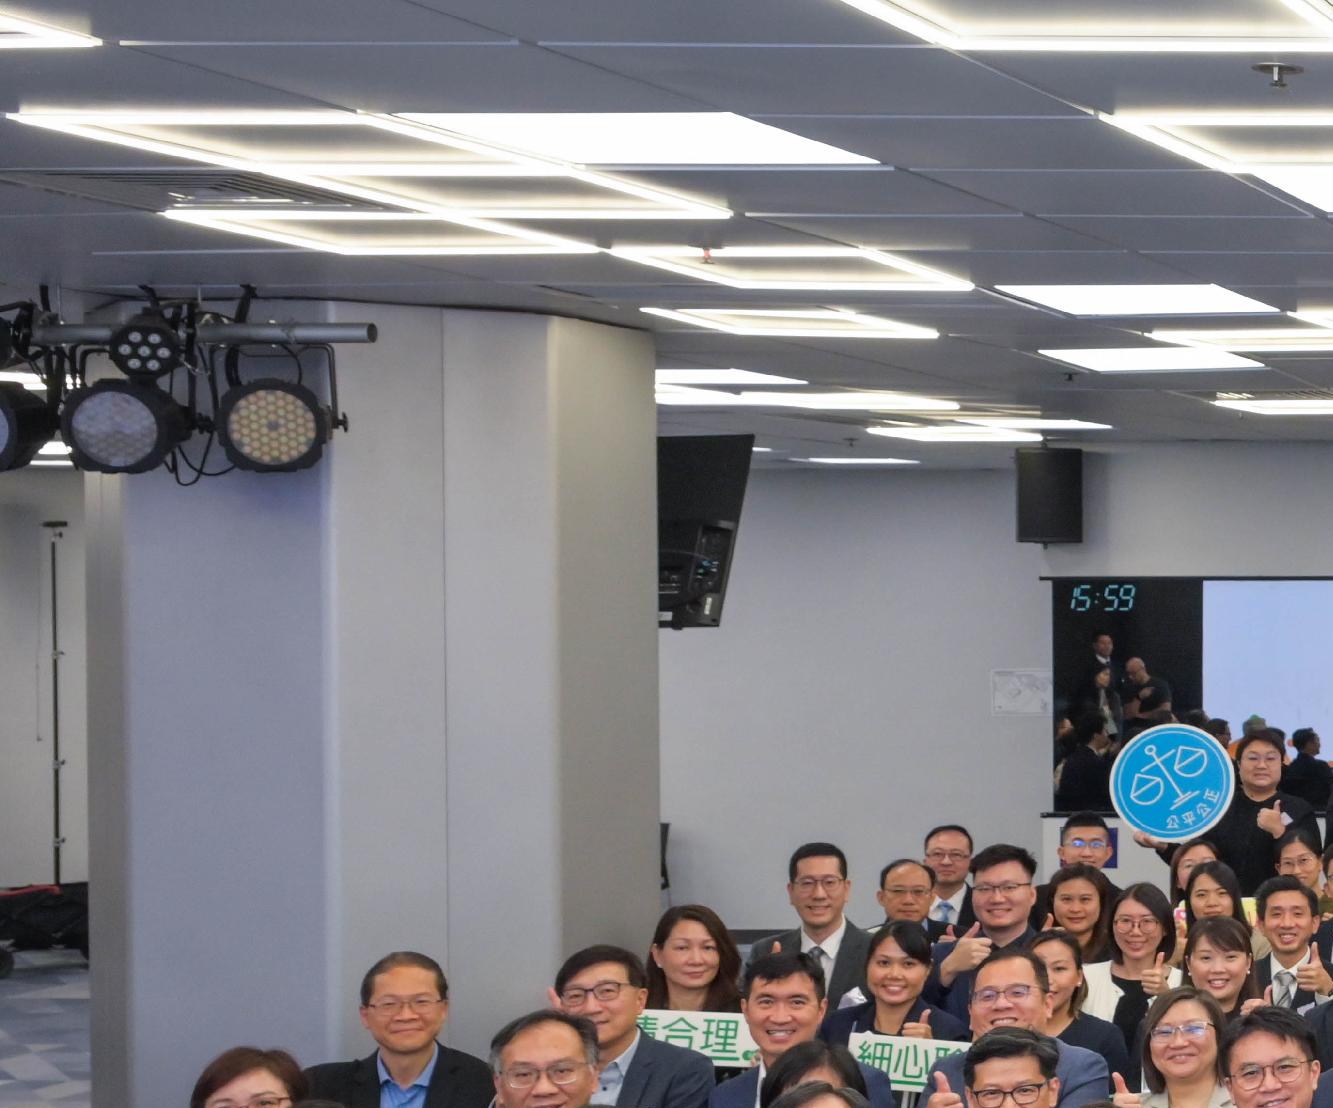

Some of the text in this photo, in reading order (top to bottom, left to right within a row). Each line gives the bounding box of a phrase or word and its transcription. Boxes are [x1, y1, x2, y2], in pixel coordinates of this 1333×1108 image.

[1070, 584, 1136, 611] 15:59
[1166, 788, 1220, 829] 公平公正
